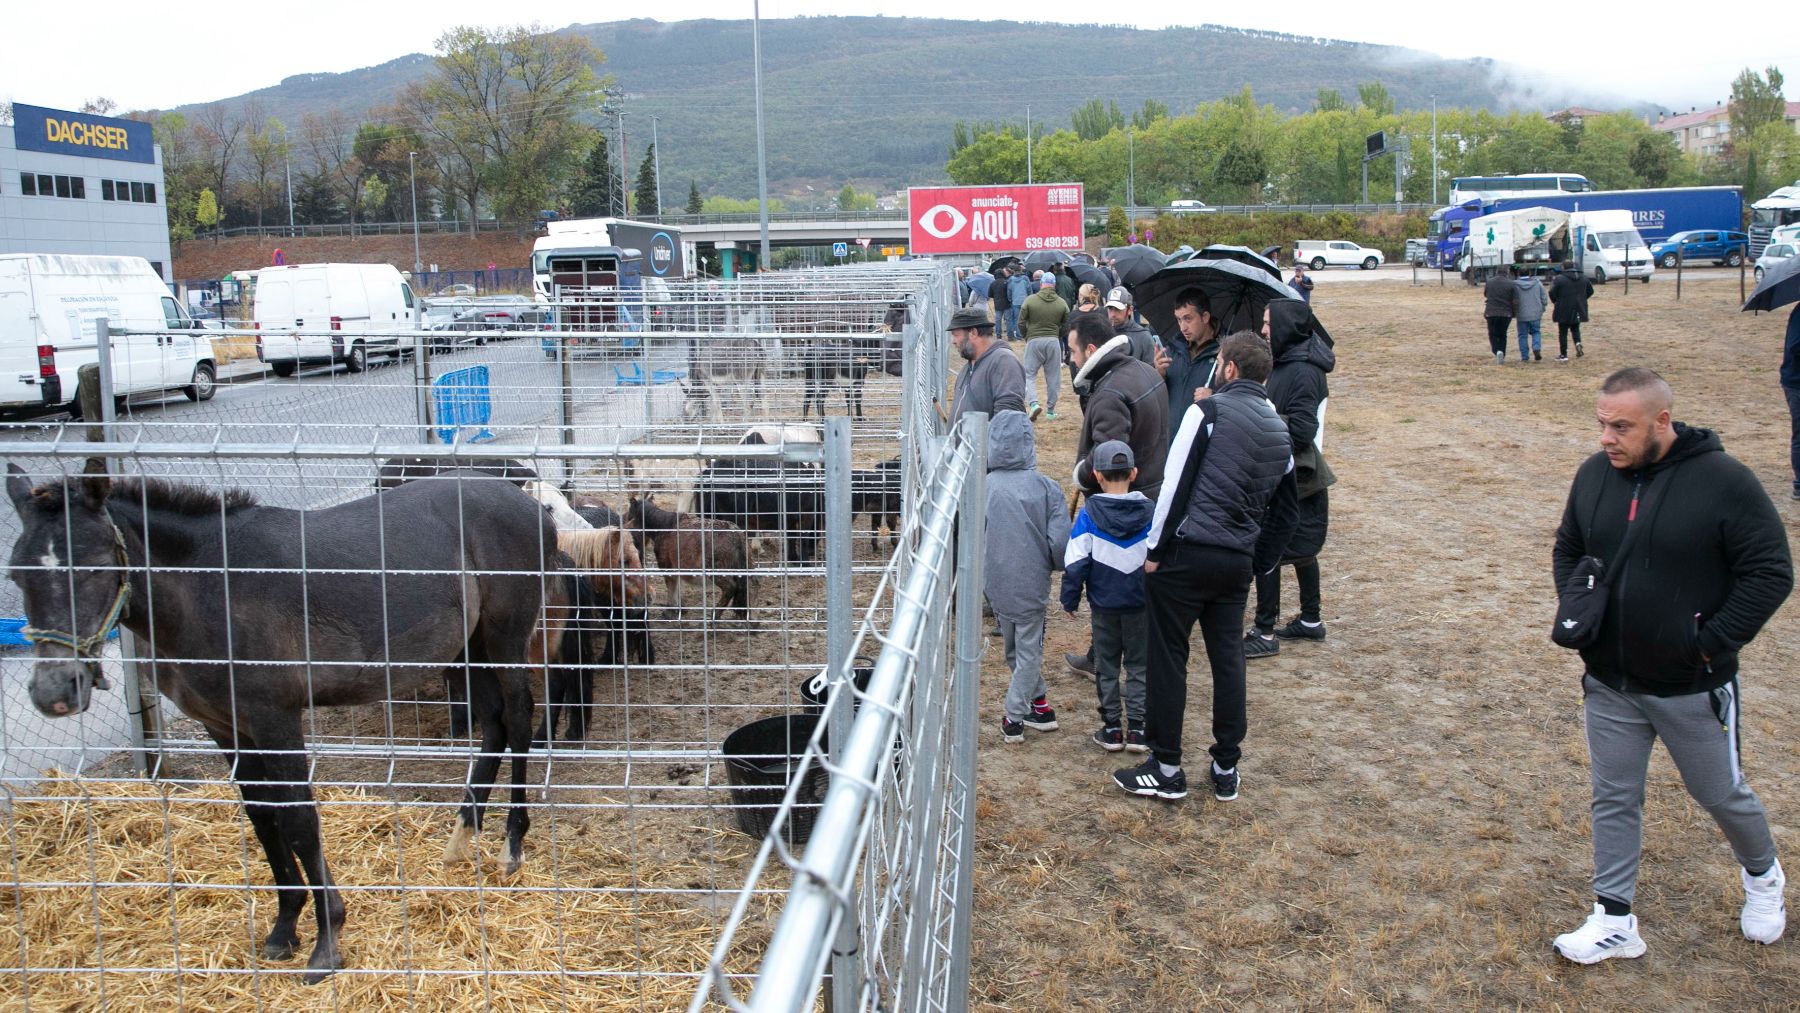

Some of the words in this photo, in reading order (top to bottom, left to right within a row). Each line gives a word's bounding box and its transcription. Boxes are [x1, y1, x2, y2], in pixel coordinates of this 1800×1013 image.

[46, 118, 128, 150] DACHSER
[971, 194, 1013, 208] anunciate
[971, 201, 1019, 243] AQUÍ
[1633, 209, 1665, 222] IRES
[1025, 237, 1043, 249] 639
[1043, 236, 1061, 248] 490
[1061, 236, 1079, 248] 298
